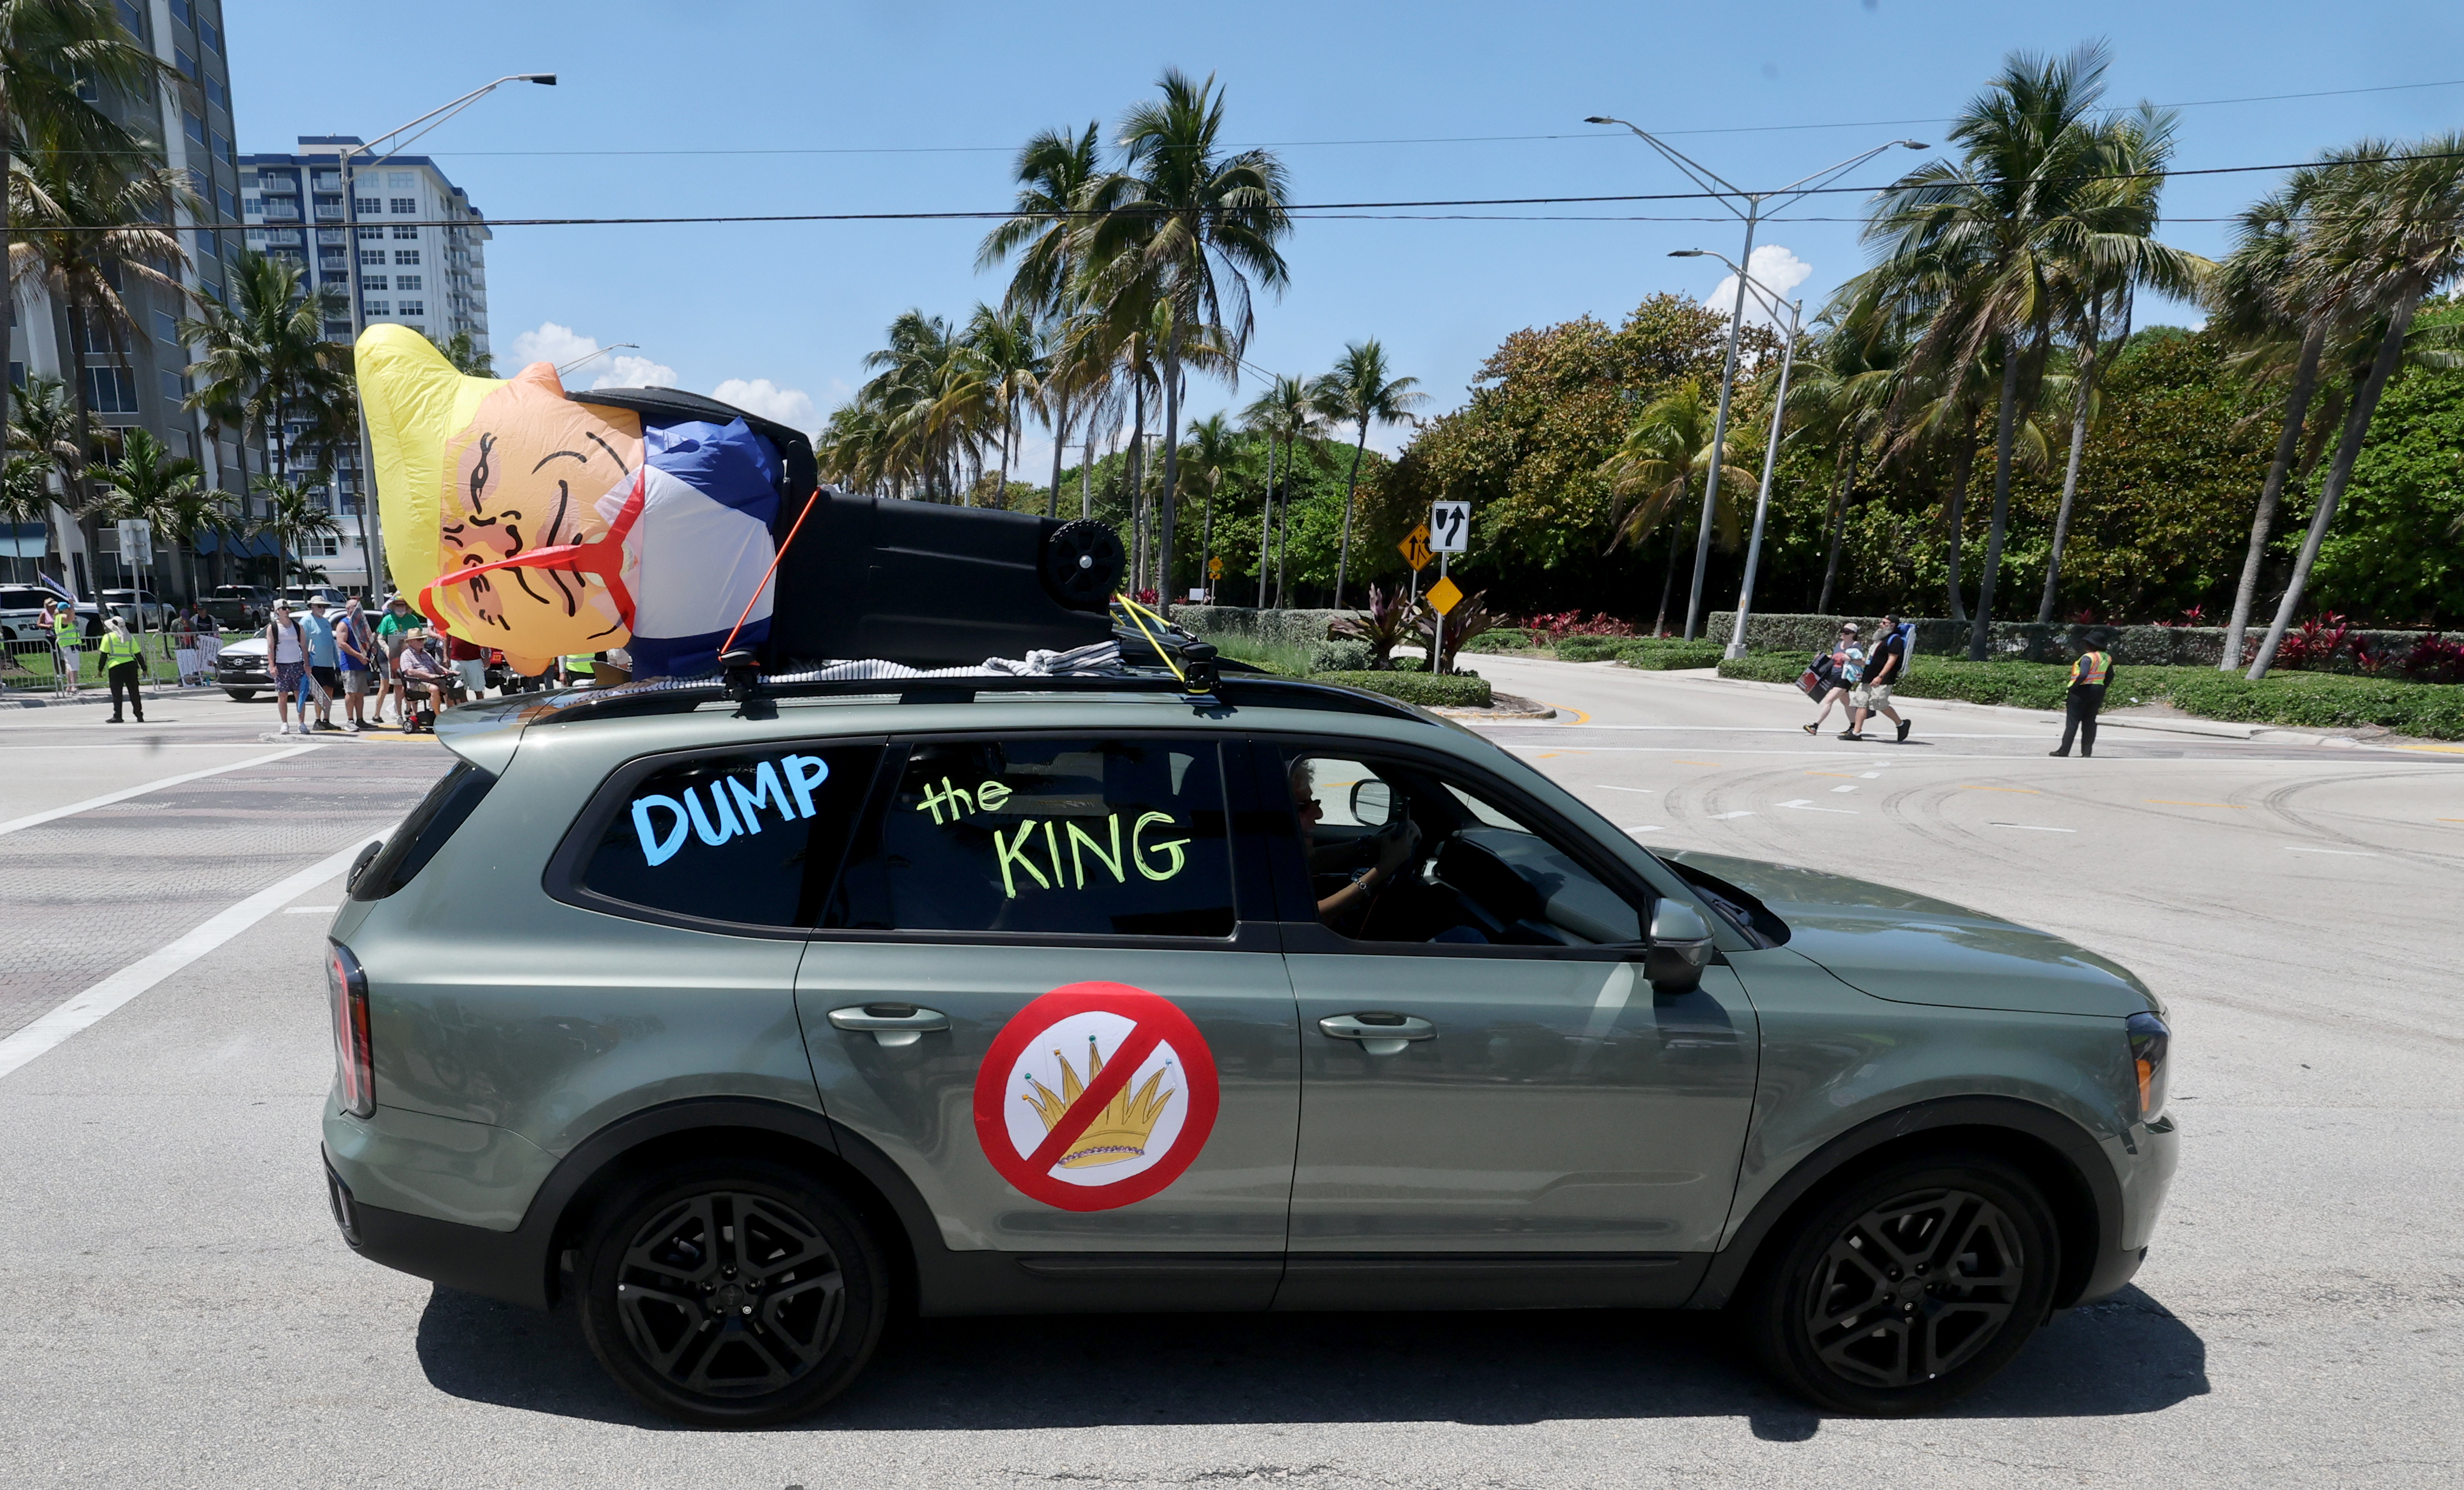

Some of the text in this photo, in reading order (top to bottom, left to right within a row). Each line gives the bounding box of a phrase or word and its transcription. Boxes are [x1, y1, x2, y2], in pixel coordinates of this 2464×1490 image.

[631, 754, 829, 867] DUMP
[916, 776, 1013, 825] the
[993, 811, 1191, 899] KING
